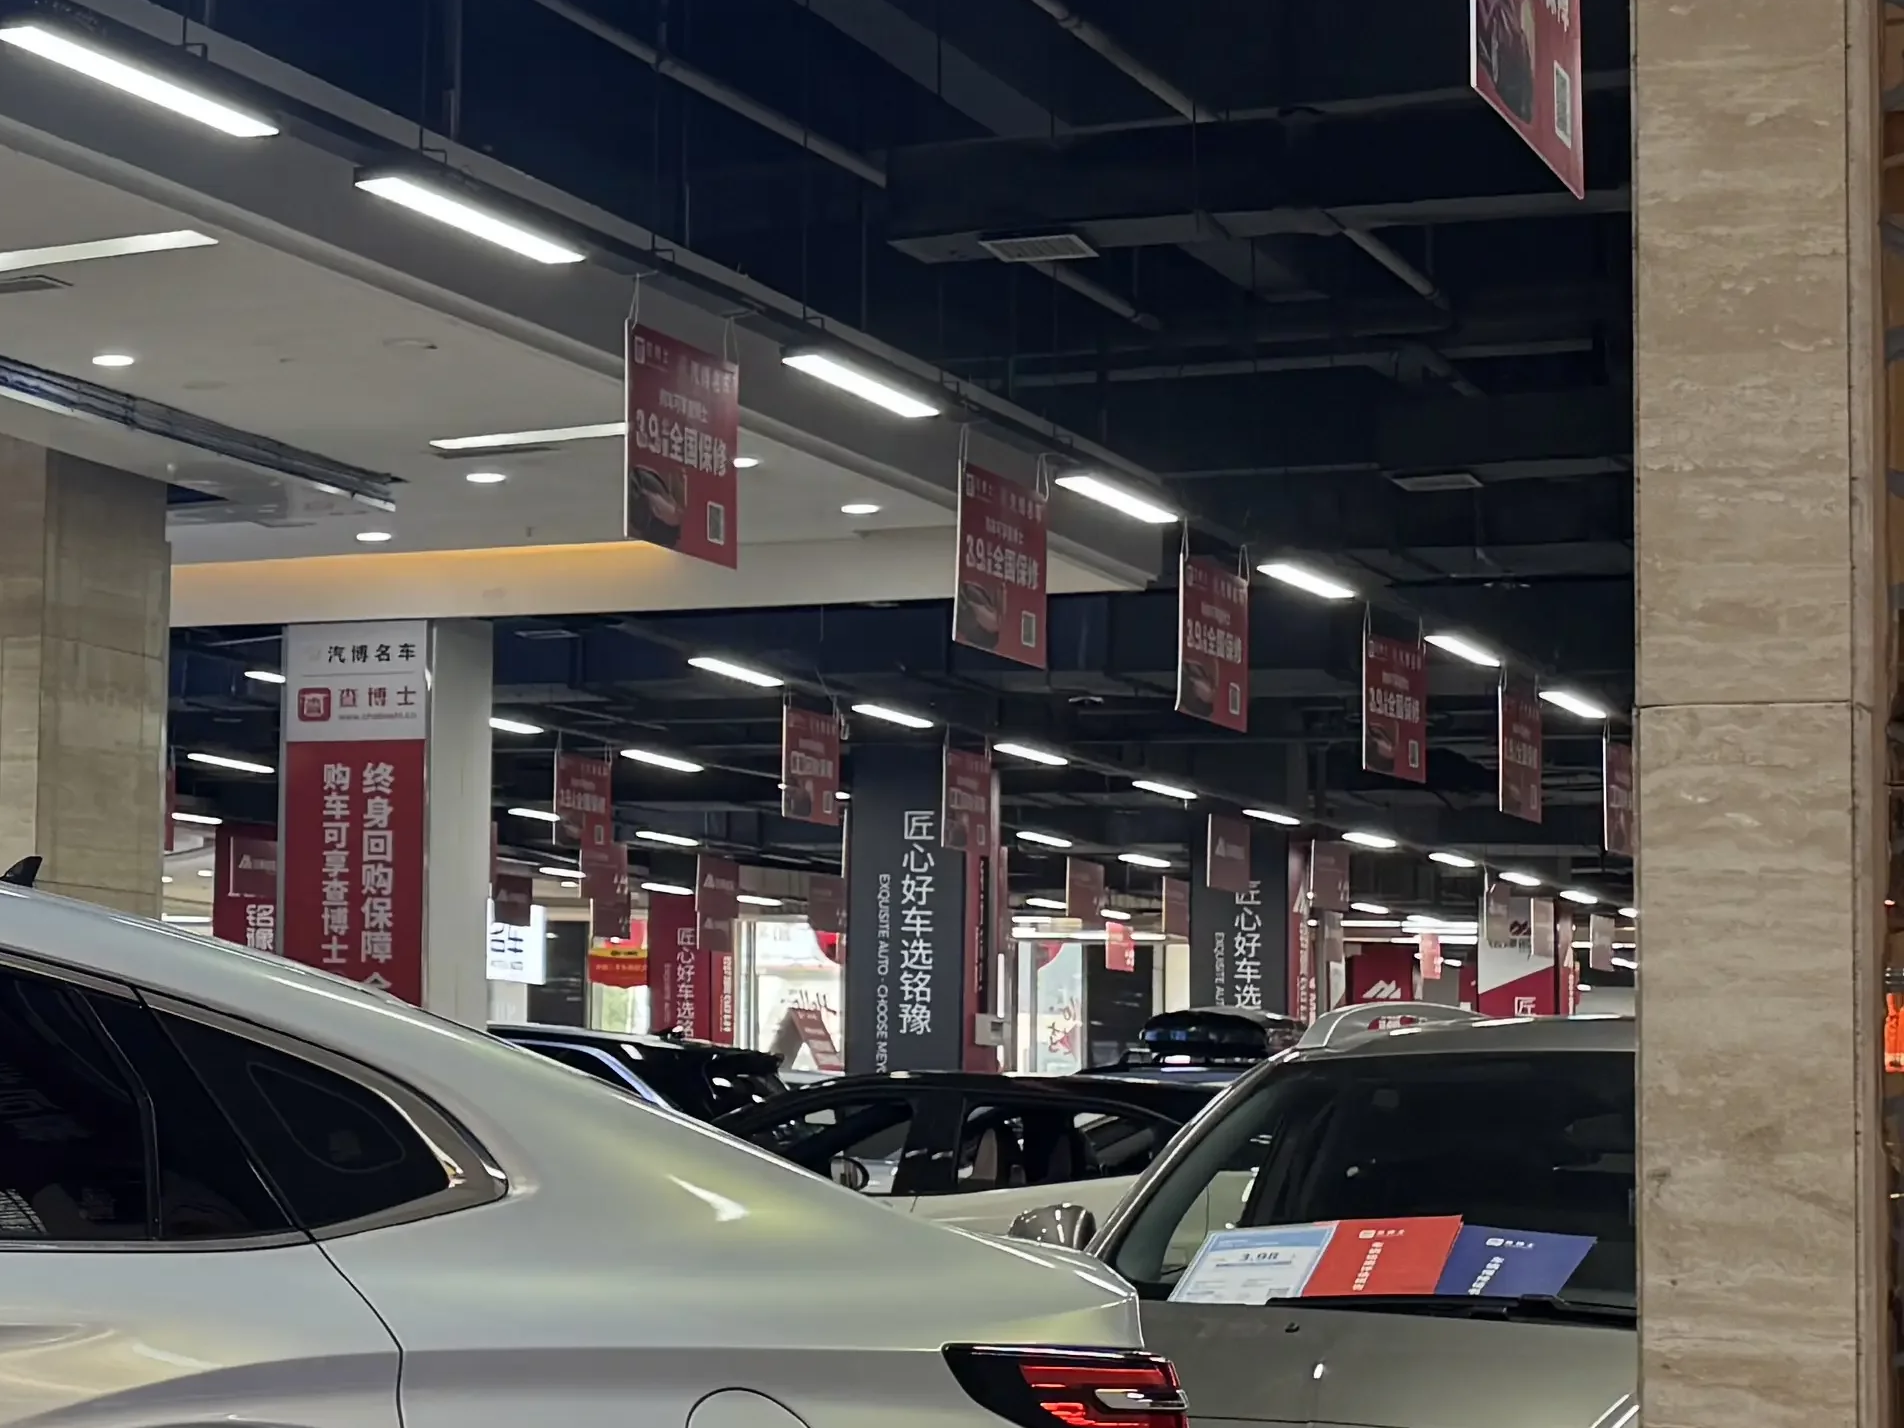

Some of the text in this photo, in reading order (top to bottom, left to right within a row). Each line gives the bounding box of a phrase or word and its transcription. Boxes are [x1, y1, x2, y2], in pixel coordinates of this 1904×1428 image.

[328, 643, 417, 664] 汽博名车
[338, 686, 417, 708] 查博士
[321, 763, 350, 964] 购车可享查博士
[361, 762, 395, 964] 终身回购保障
[898, 810, 935, 1036] 匠心好车选铭豫
[877, 940, 890, 976] AUTO
[876, 983, 890, 1038] CHOOSE
